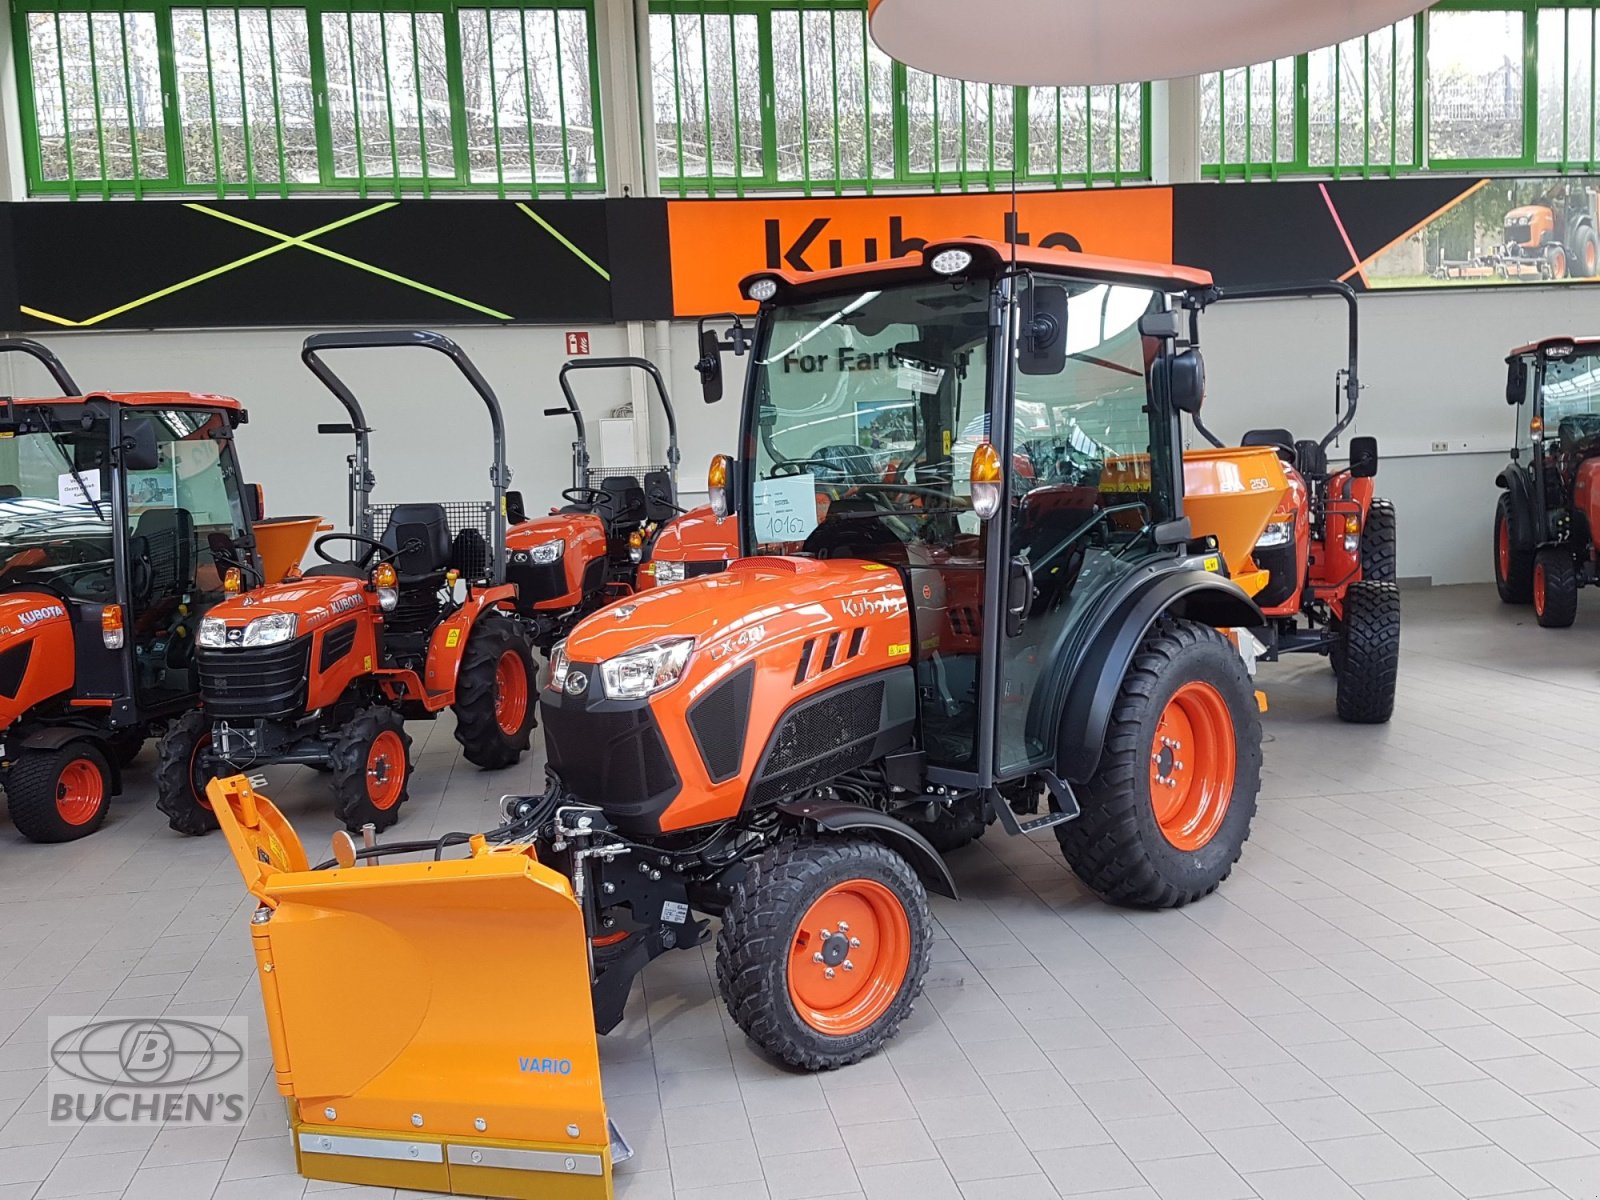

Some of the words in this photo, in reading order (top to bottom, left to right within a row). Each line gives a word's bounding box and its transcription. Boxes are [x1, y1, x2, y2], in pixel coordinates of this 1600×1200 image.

[783, 349, 828, 373] For
[1249, 478, 1269, 490] 250
[767, 516, 804, 537] 10162
[331, 593, 364, 614] KUBOTA
[841, 593, 900, 617] Kubota
[17, 605, 64, 625] KUBOTA
[518, 1056, 572, 1075] VARIO
